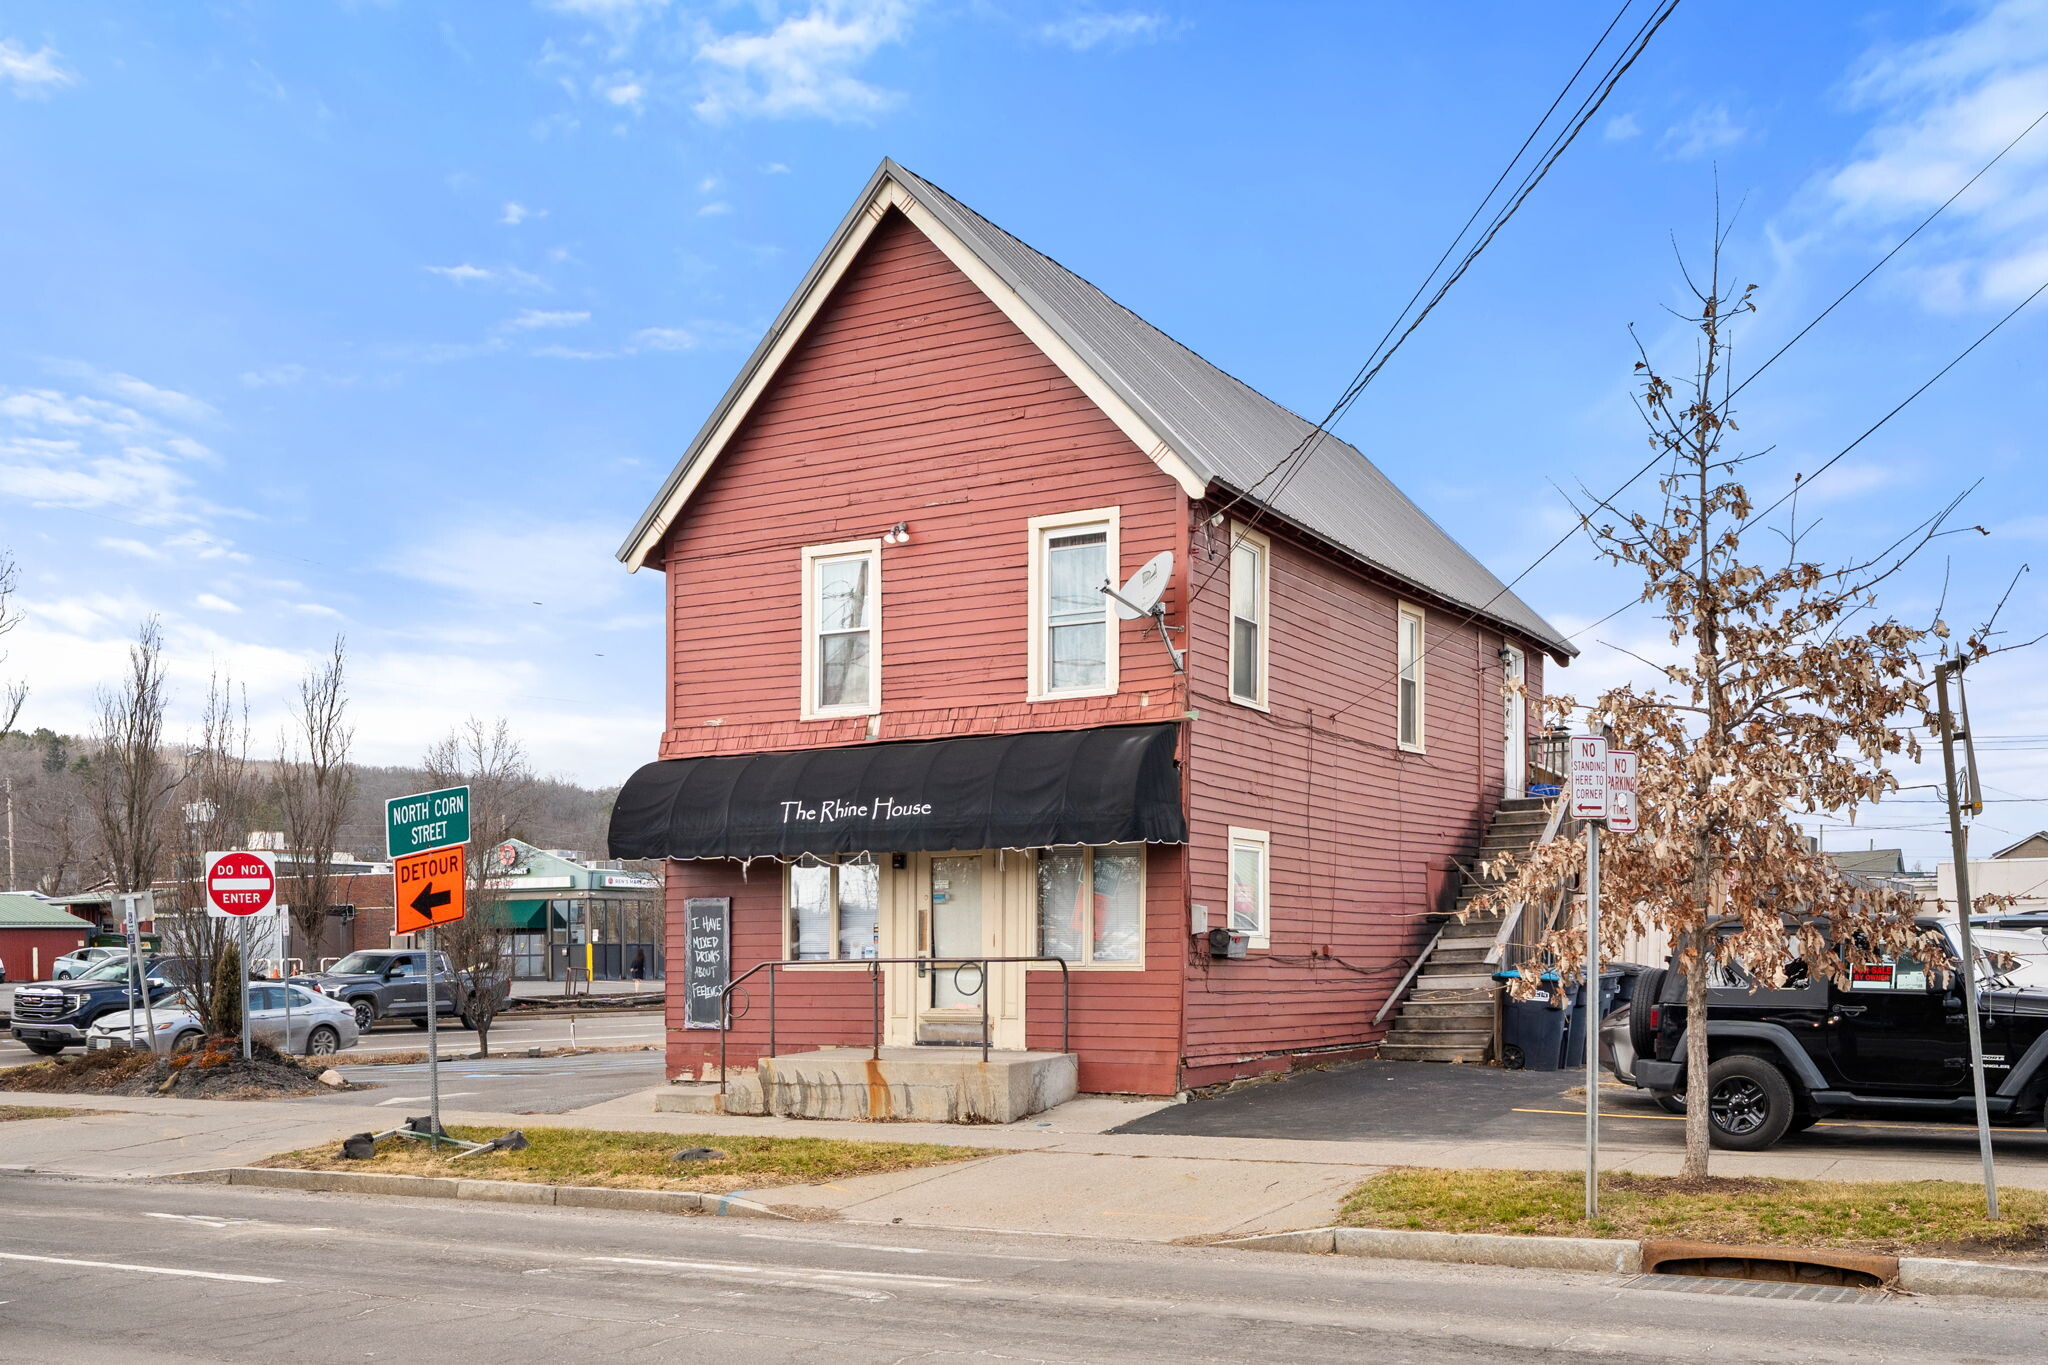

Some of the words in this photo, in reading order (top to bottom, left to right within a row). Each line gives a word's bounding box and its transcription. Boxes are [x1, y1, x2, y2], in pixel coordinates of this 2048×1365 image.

[1582, 743, 1596, 757] NO
[1573, 761, 1605, 771] STANDING
[1614, 758, 1627, 773] NO
[1575, 775, 1593, 785] HERE
[1596, 775, 1603, 785] TO
[1608, 776, 1634, 790] PARKING
[1576, 789, 1603, 799] CORNER
[393, 801, 429, 825] NORTH
[434, 795, 464, 817] CORN
[780, 800, 816, 823] The
[820, 799, 867, 823] Rhine
[872, 797, 932, 820] House
[411, 821, 447, 844] STREET
[217, 865, 234, 875] DO
[241, 865, 264, 875] NOT
[401, 855, 458, 883] DETOUR
[223, 893, 260, 903] ENTER
[692, 917, 700, 930] I
[702, 915, 722, 932] HAVE
[692, 936, 719, 950] MIXED
[694, 950, 720, 962] DRINKS
[694, 965, 718, 978] ABOUT
[1871, 966, 1892, 974] SALE
[692, 982, 722, 999] FEELINGS
